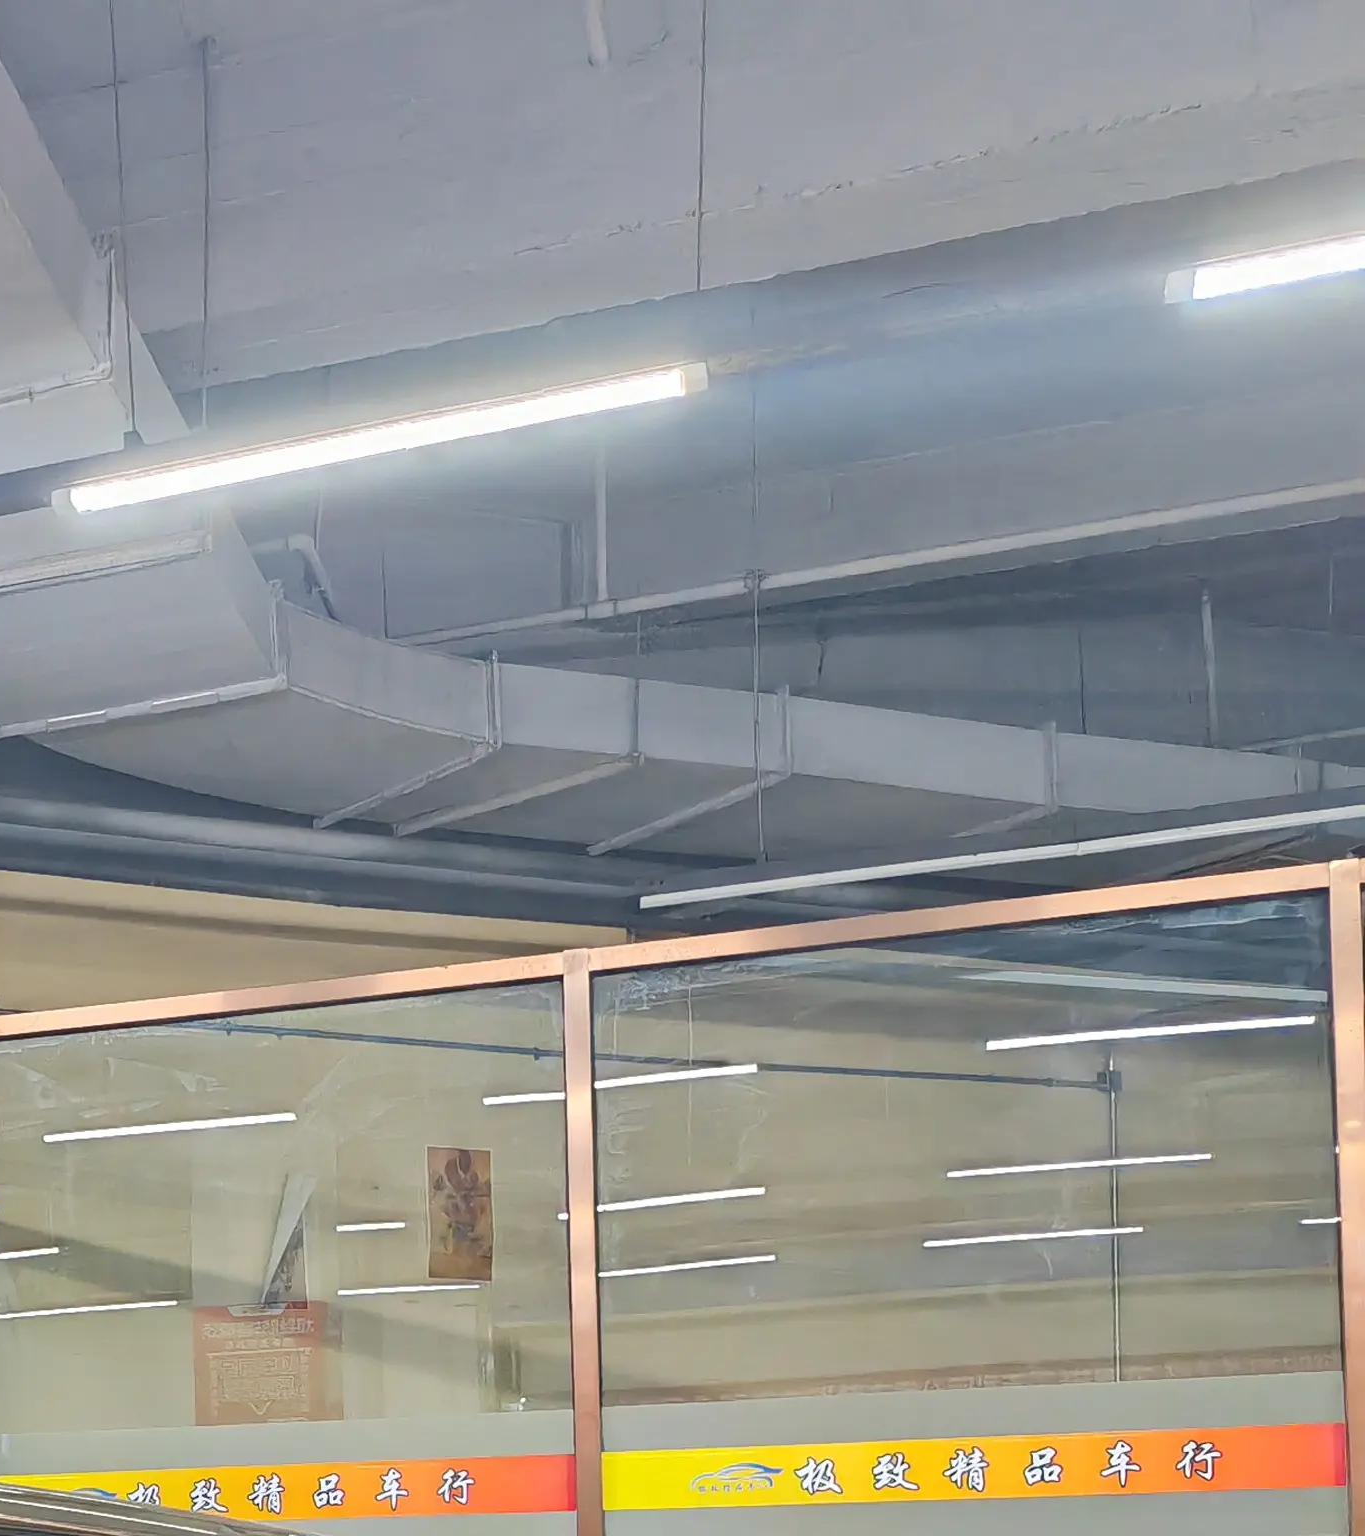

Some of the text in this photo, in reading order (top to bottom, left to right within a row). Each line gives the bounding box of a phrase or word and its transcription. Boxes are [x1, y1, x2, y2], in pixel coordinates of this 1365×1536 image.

[794, 1439, 1222, 1495] 极致精品车行
